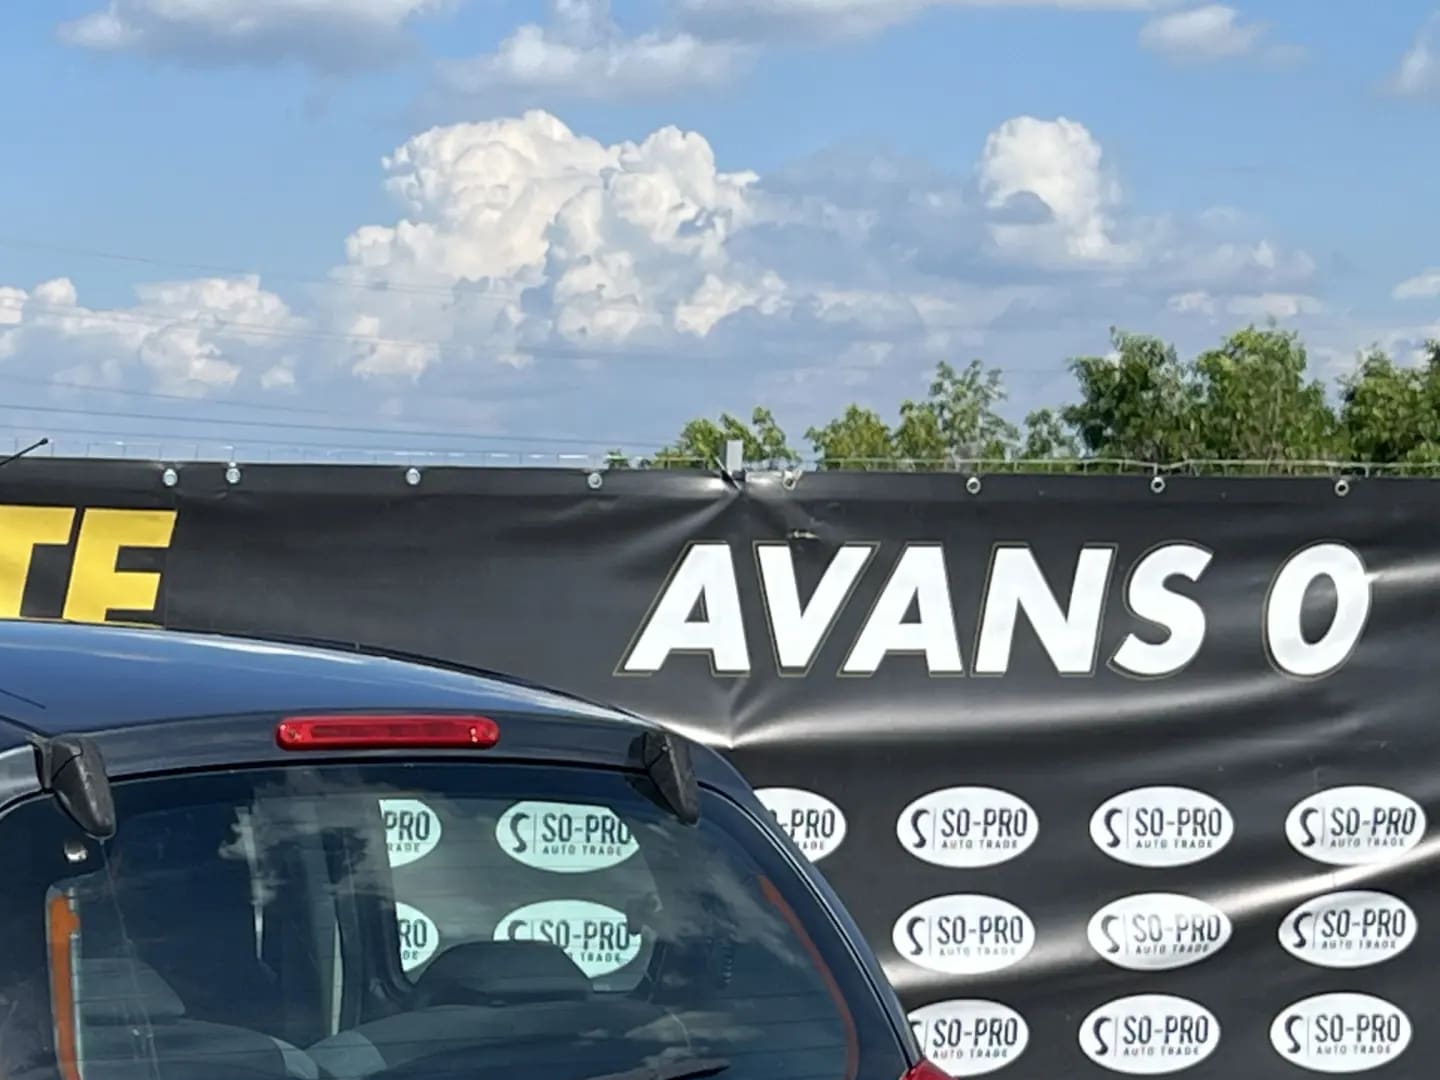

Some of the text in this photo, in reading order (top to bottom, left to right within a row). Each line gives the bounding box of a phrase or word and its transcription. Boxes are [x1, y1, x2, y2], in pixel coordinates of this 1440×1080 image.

[614, 540, 1213, 680] AVANS
[941, 808, 1027, 837] SO-PRO
[1135, 807, 1222, 837] SO-PRO
[1330, 807, 1416, 837] SO-PRO
[937, 915, 1024, 945] SO-PRO
[1132, 913, 1221, 943] SO-PRO
[1321, 908, 1406, 938] SO-PRO
[932, 1018, 1018, 1047] SO-PRO
[1123, 1015, 1208, 1045] SO-PRO
[1315, 1013, 1401, 1043] SO-PRO
